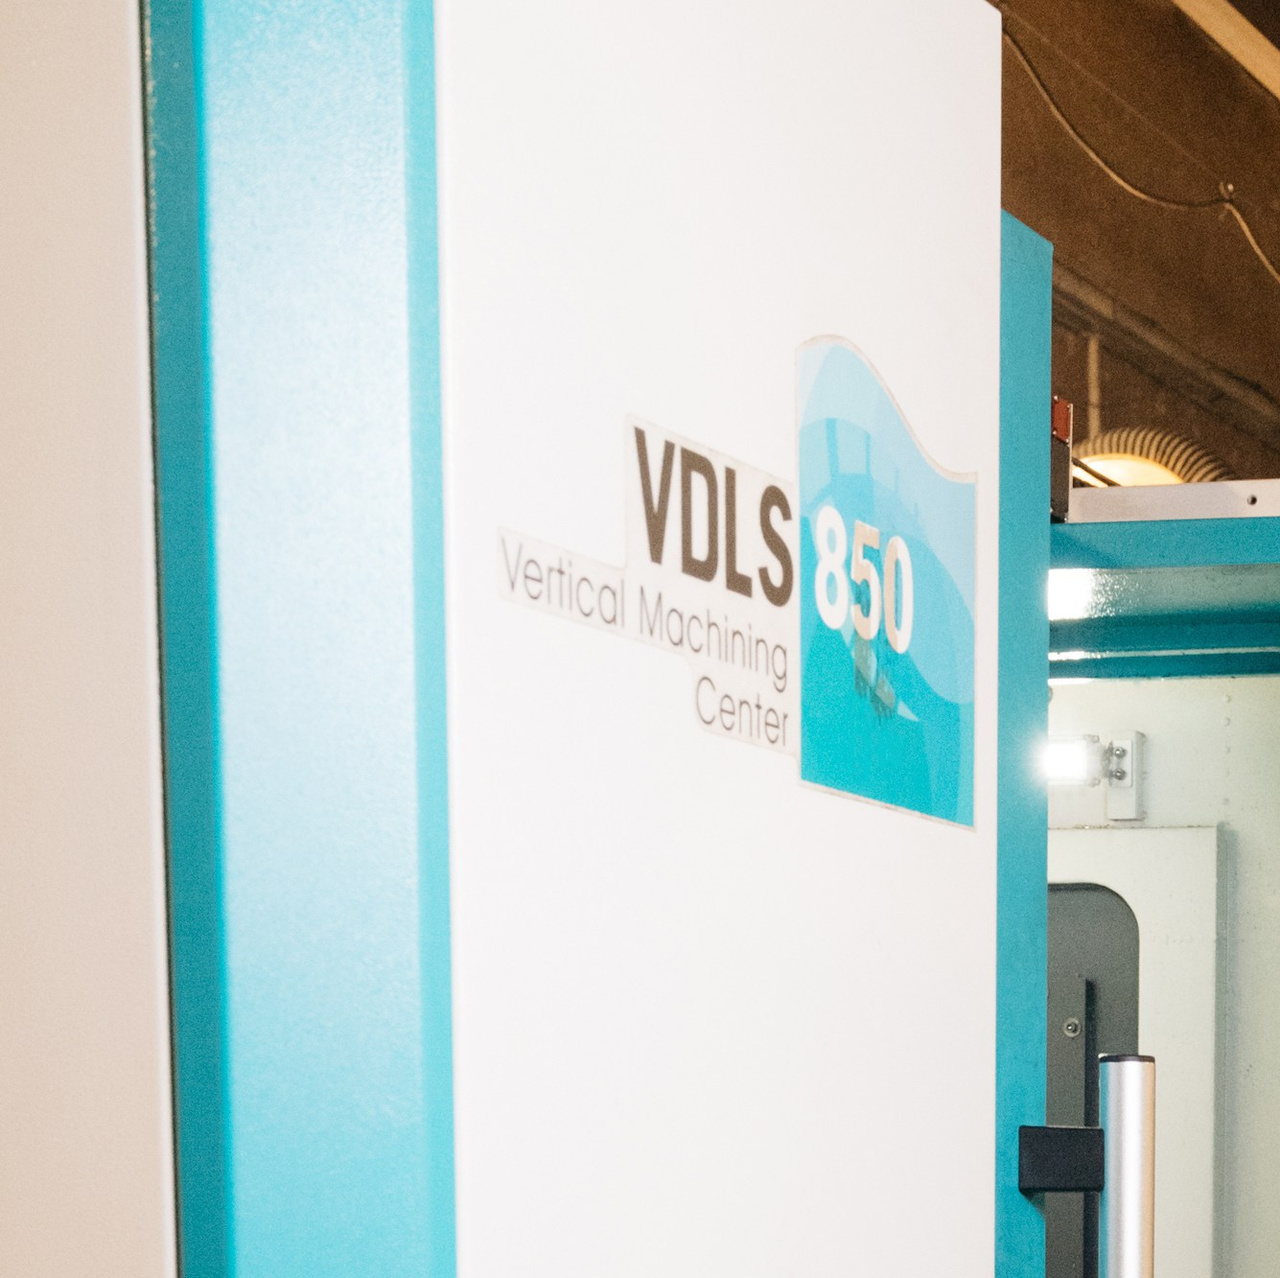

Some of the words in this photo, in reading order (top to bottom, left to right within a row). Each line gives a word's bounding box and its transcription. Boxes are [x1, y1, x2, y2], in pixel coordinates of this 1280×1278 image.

[501, 536, 625, 629] Vertical
[640, 584, 788, 693] Machining
[634, 425, 793, 607] VDLS
[814, 504, 913, 654] 850
[696, 676, 788, 747] Center
